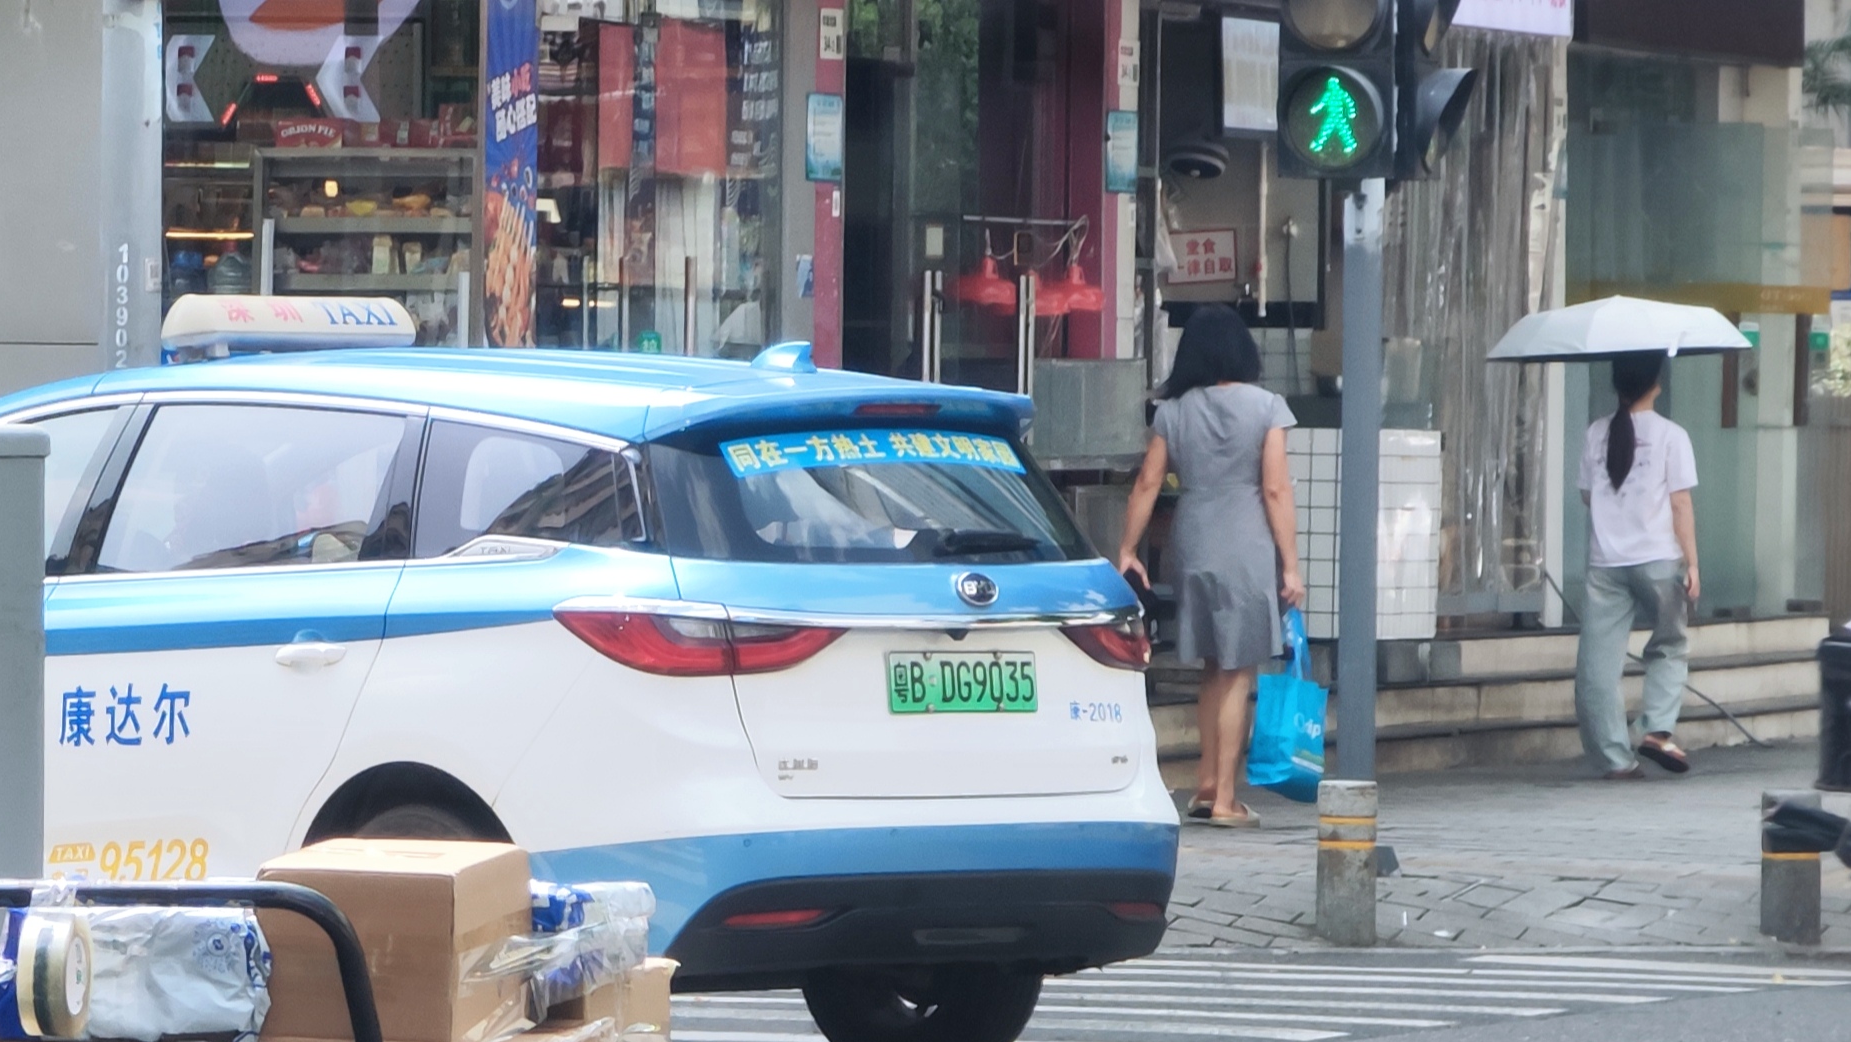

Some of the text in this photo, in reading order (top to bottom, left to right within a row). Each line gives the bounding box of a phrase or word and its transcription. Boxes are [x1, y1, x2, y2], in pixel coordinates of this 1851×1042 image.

[115, 242, 129, 369] 103902
[313, 301, 398, 326] TAXI
[963, 580, 997, 597] BYD
[59, 683, 191, 747] 康达尔
[56, 845, 91, 862] TAXI
[100, 837, 210, 882] 95128
